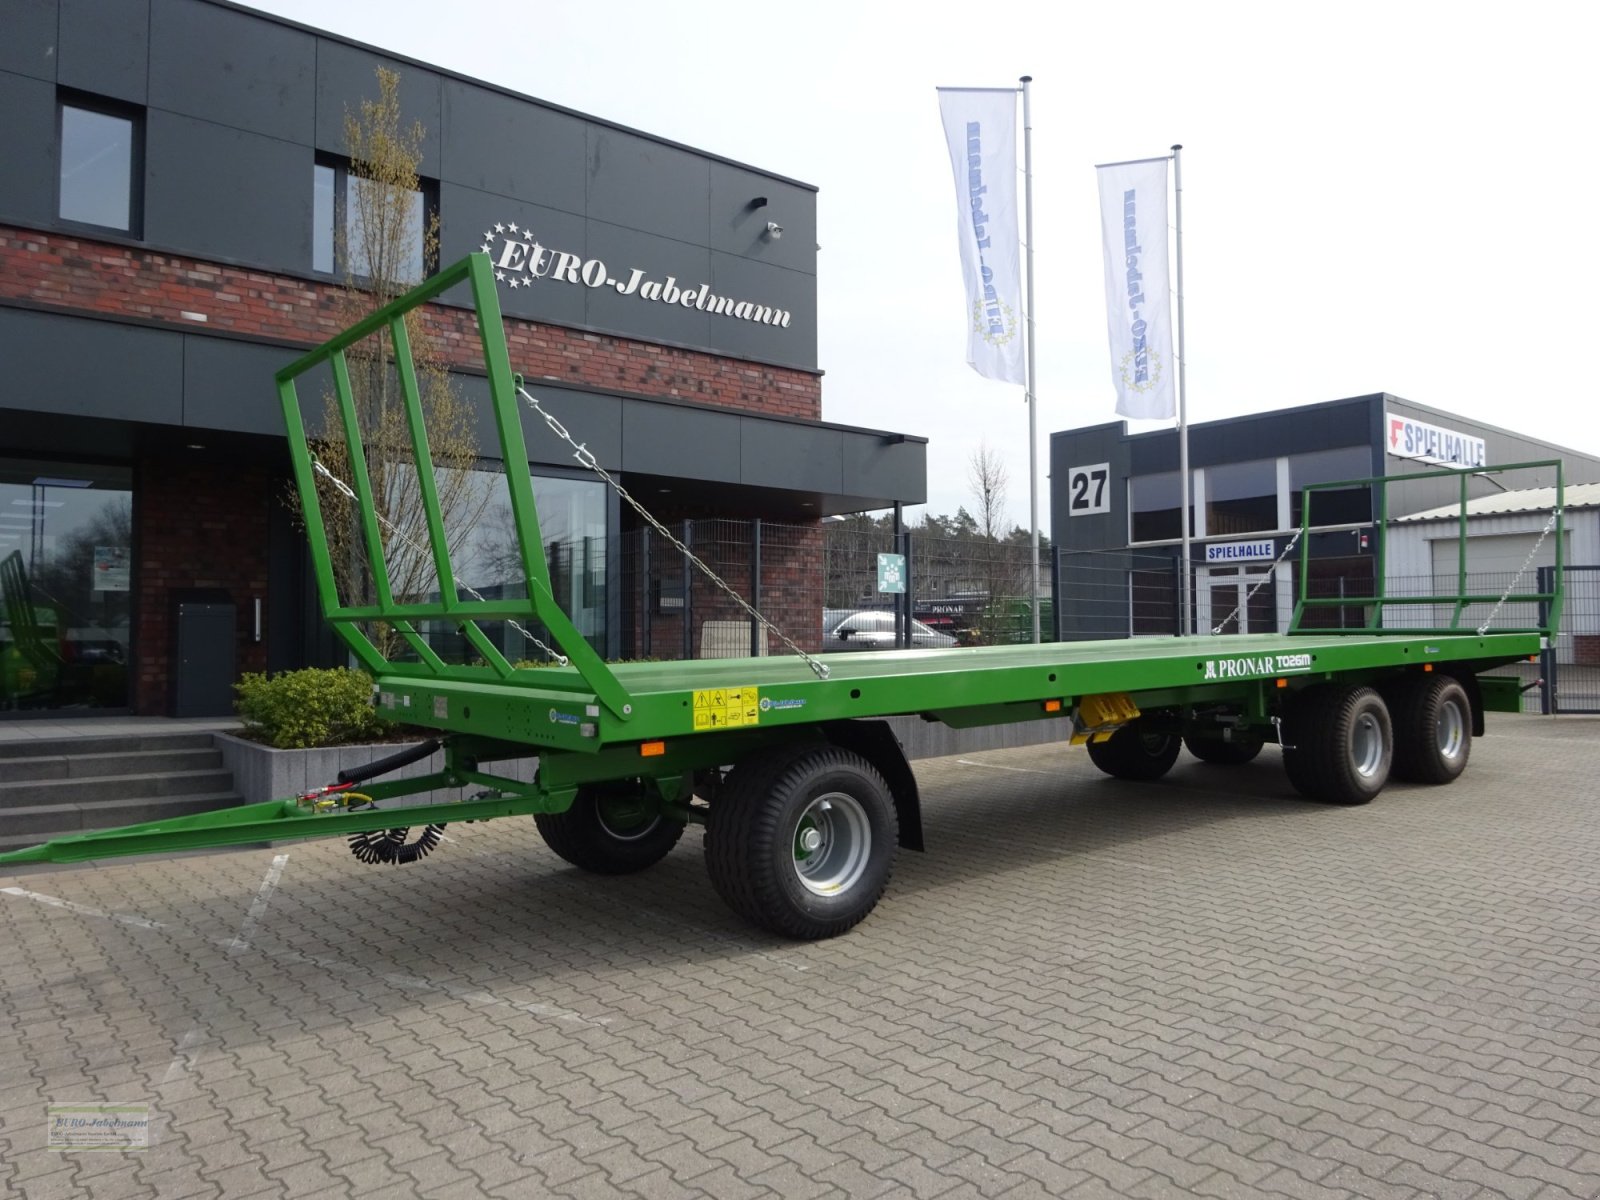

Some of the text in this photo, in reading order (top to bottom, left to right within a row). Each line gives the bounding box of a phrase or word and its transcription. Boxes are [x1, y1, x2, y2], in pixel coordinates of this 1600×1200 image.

[496, 239, 791, 328] EURO-Jabelmann
[1404, 423, 1484, 468] SPIELHALLE
[1072, 470, 1107, 510] 27
[1208, 543, 1271, 559] SPIELHALLE
[932, 605, 963, 613] PRONAR
[1219, 657, 1274, 677] PRONAR
